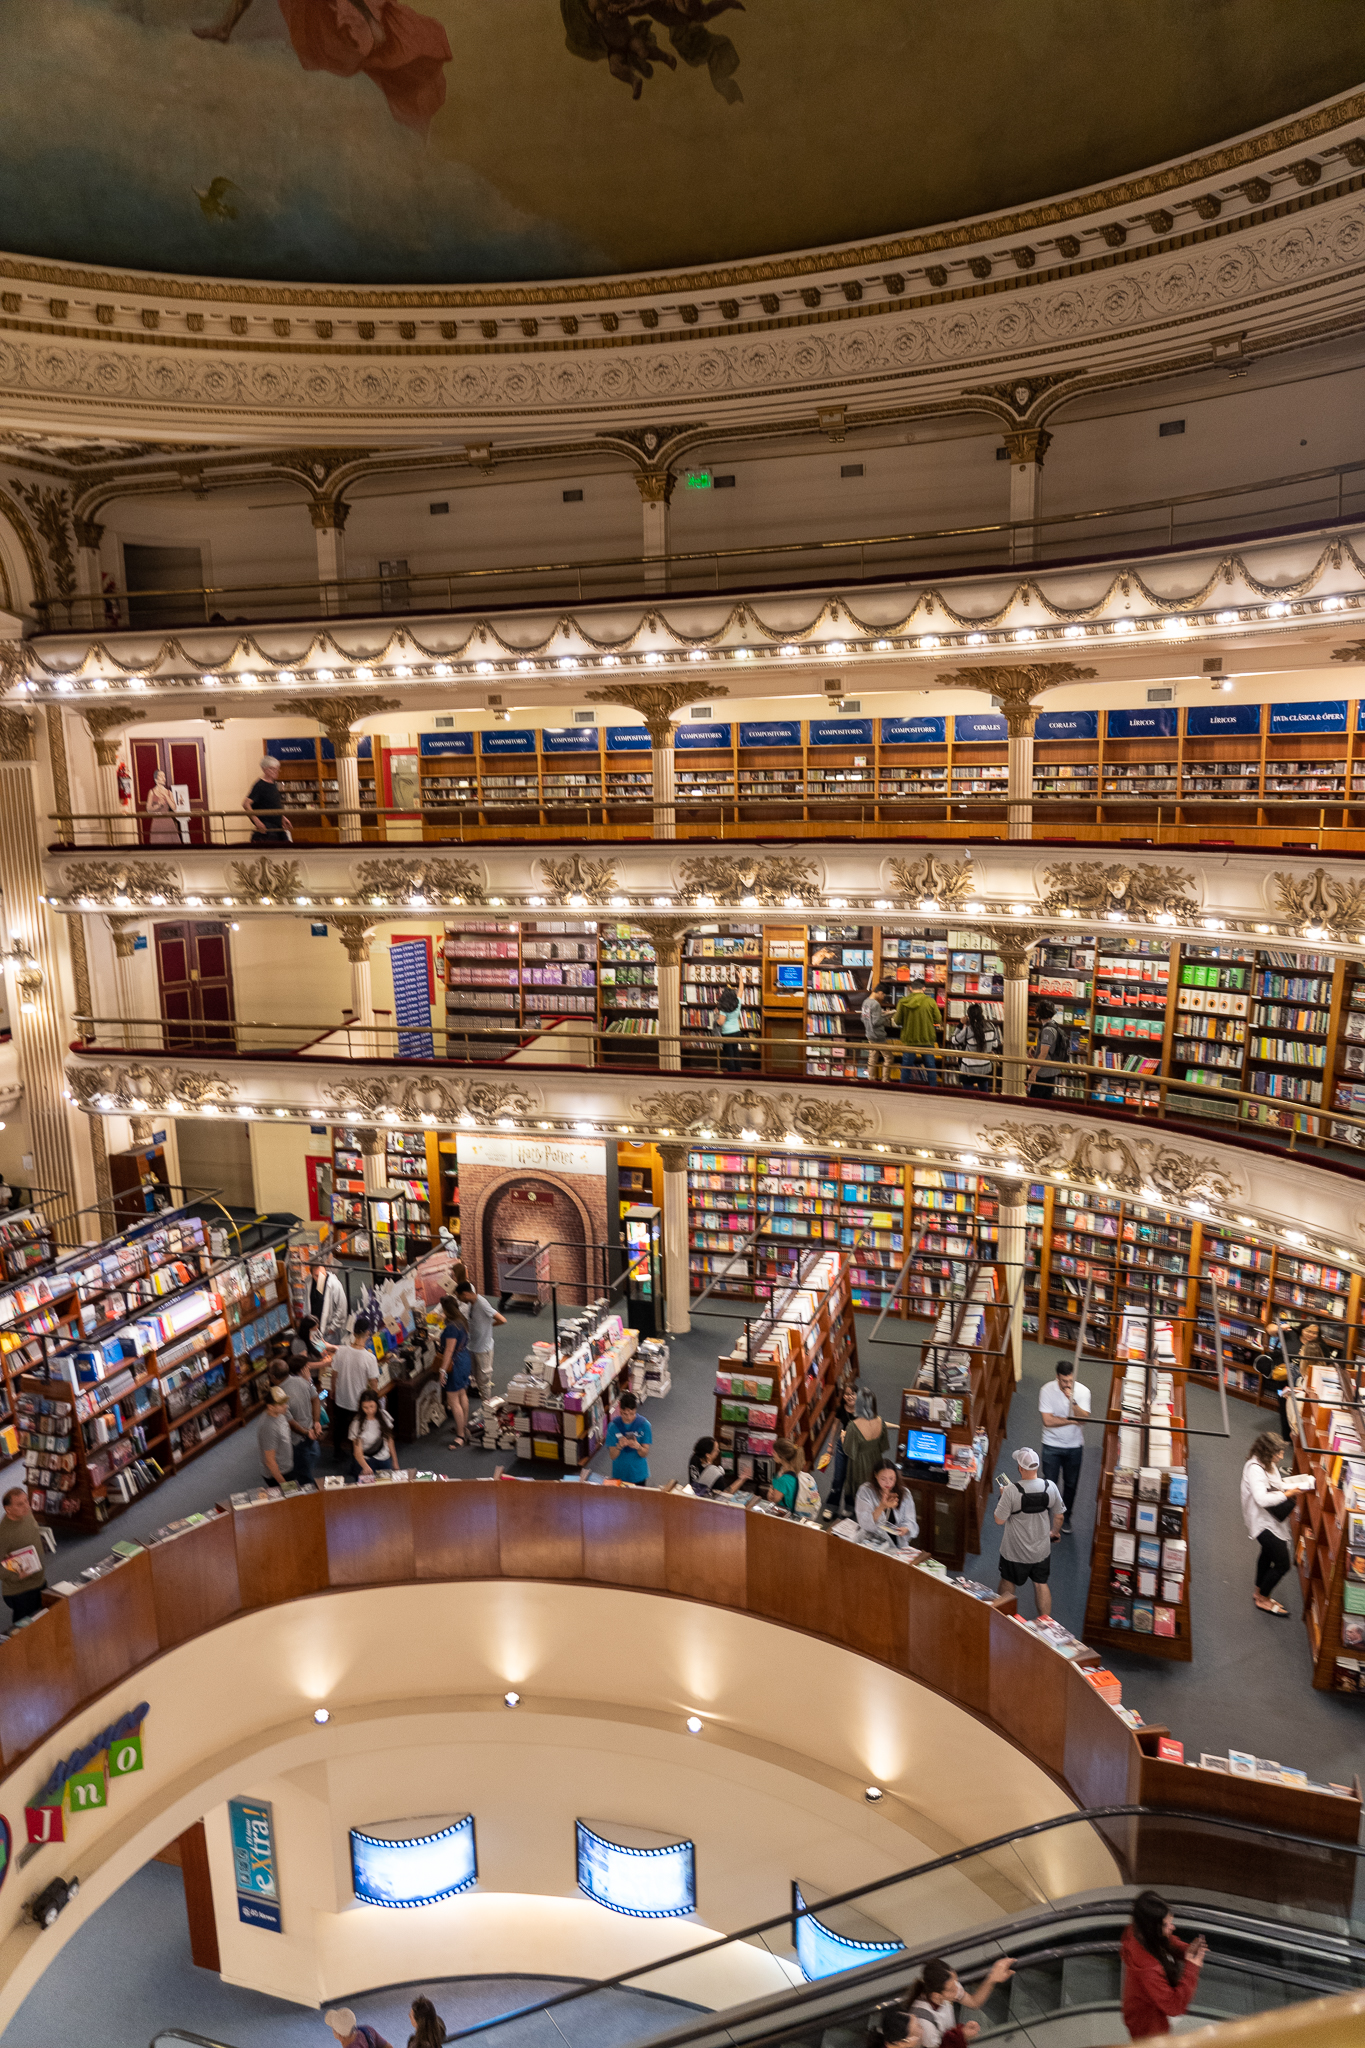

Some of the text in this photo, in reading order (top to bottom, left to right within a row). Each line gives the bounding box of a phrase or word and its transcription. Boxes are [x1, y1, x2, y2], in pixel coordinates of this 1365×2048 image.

[1209, 716, 1237, 724] LÍRICOS
[1289, 713, 1315, 722] CLÁSICA
[1321, 712, 1344, 721] ÓPERA
[1129, 719, 1156, 727] LÍRICOS
[748, 730, 792, 738] COMPOSITORES
[818, 728, 863, 736] COMPOSITORES
[890, 726, 937, 734] COMPOSITORES
[614, 734, 652, 742] COMPOSITORE
[680, 732, 723, 740] COMPOSITORES
[428, 740, 466, 748] COMPOSITORES
[516, 1145, 543, 1164] Harry
[544, 1145, 574, 1168] Potter
